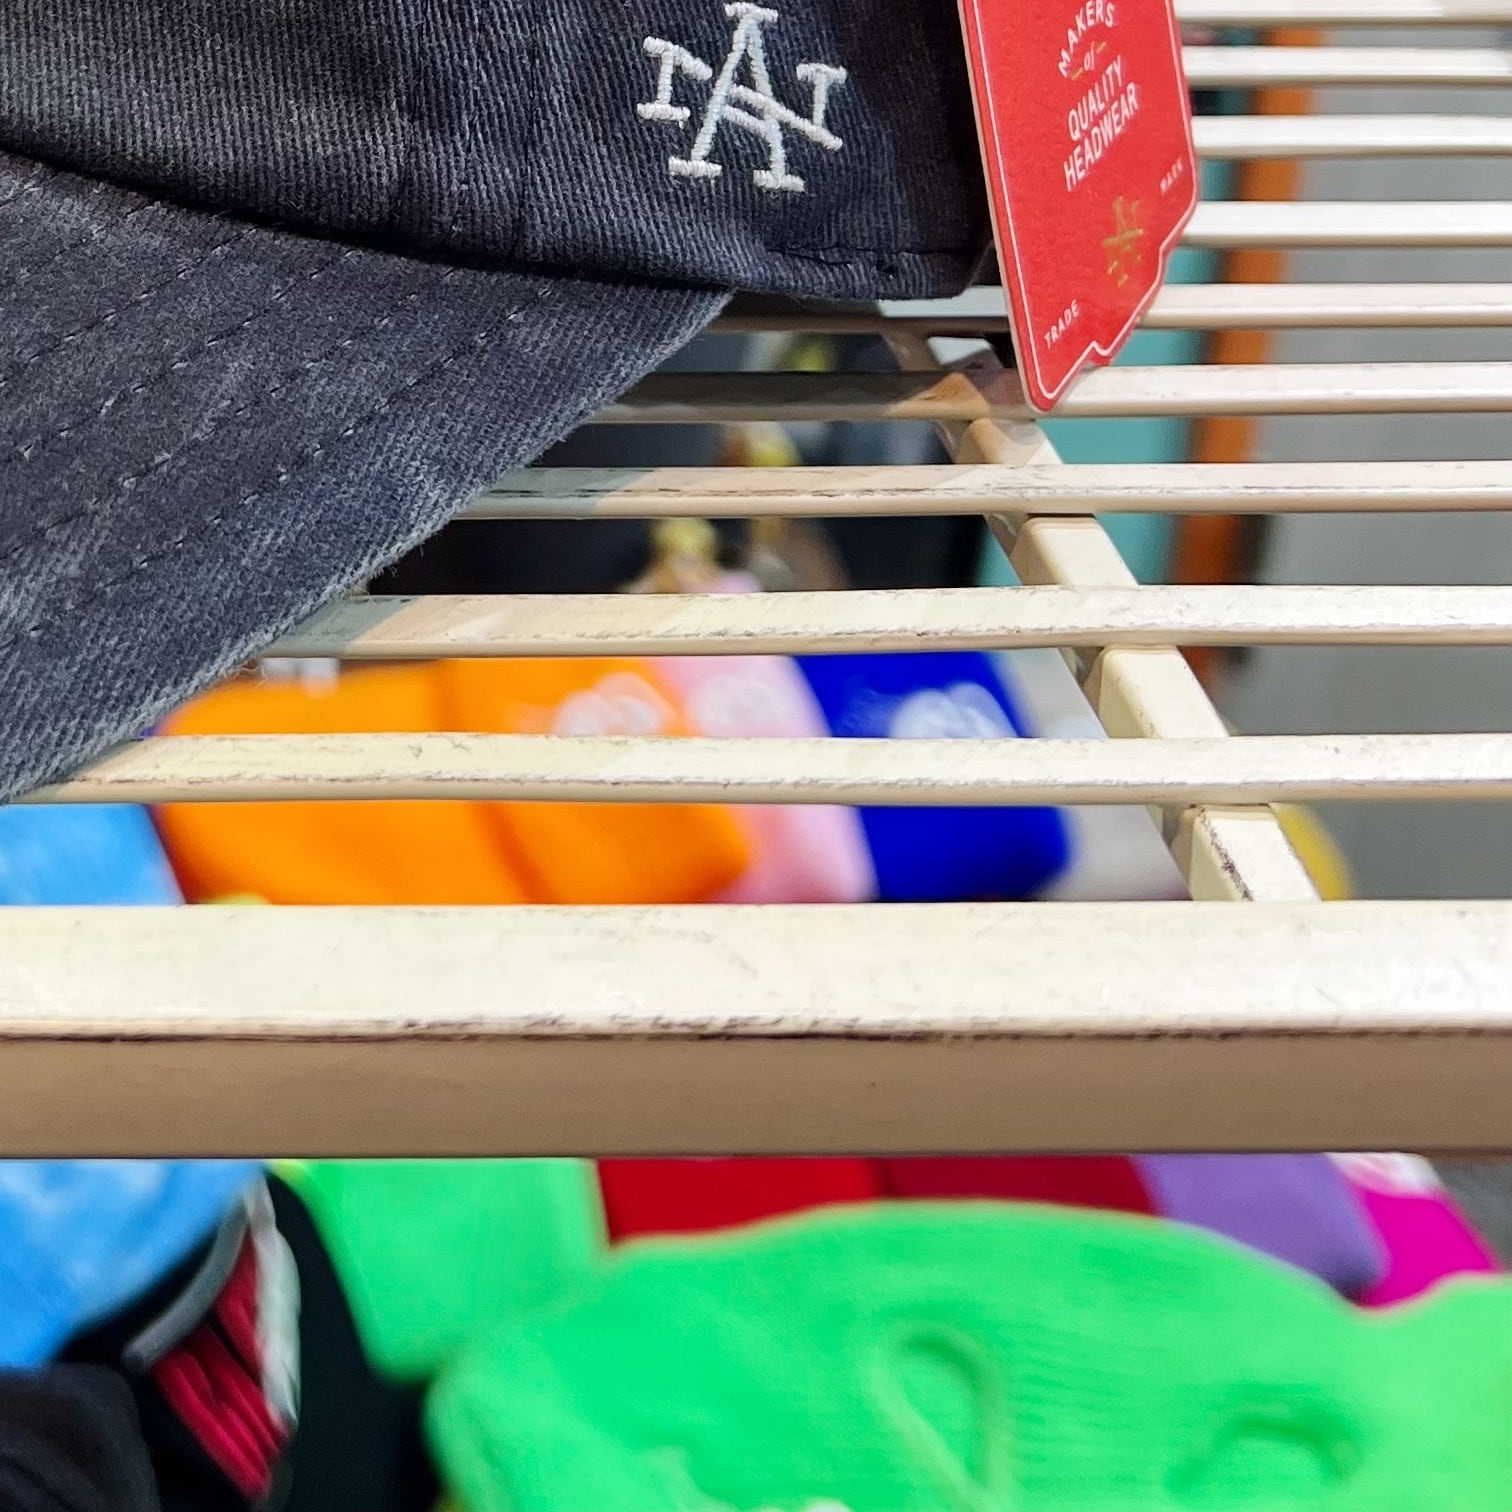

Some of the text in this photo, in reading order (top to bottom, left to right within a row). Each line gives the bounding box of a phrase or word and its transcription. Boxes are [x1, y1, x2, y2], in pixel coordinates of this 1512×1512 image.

[1063, 82, 1139, 192] HEADWEAR
[1068, 54, 1124, 141] QUALITY
[1044, 299, 1080, 349] TRADE
